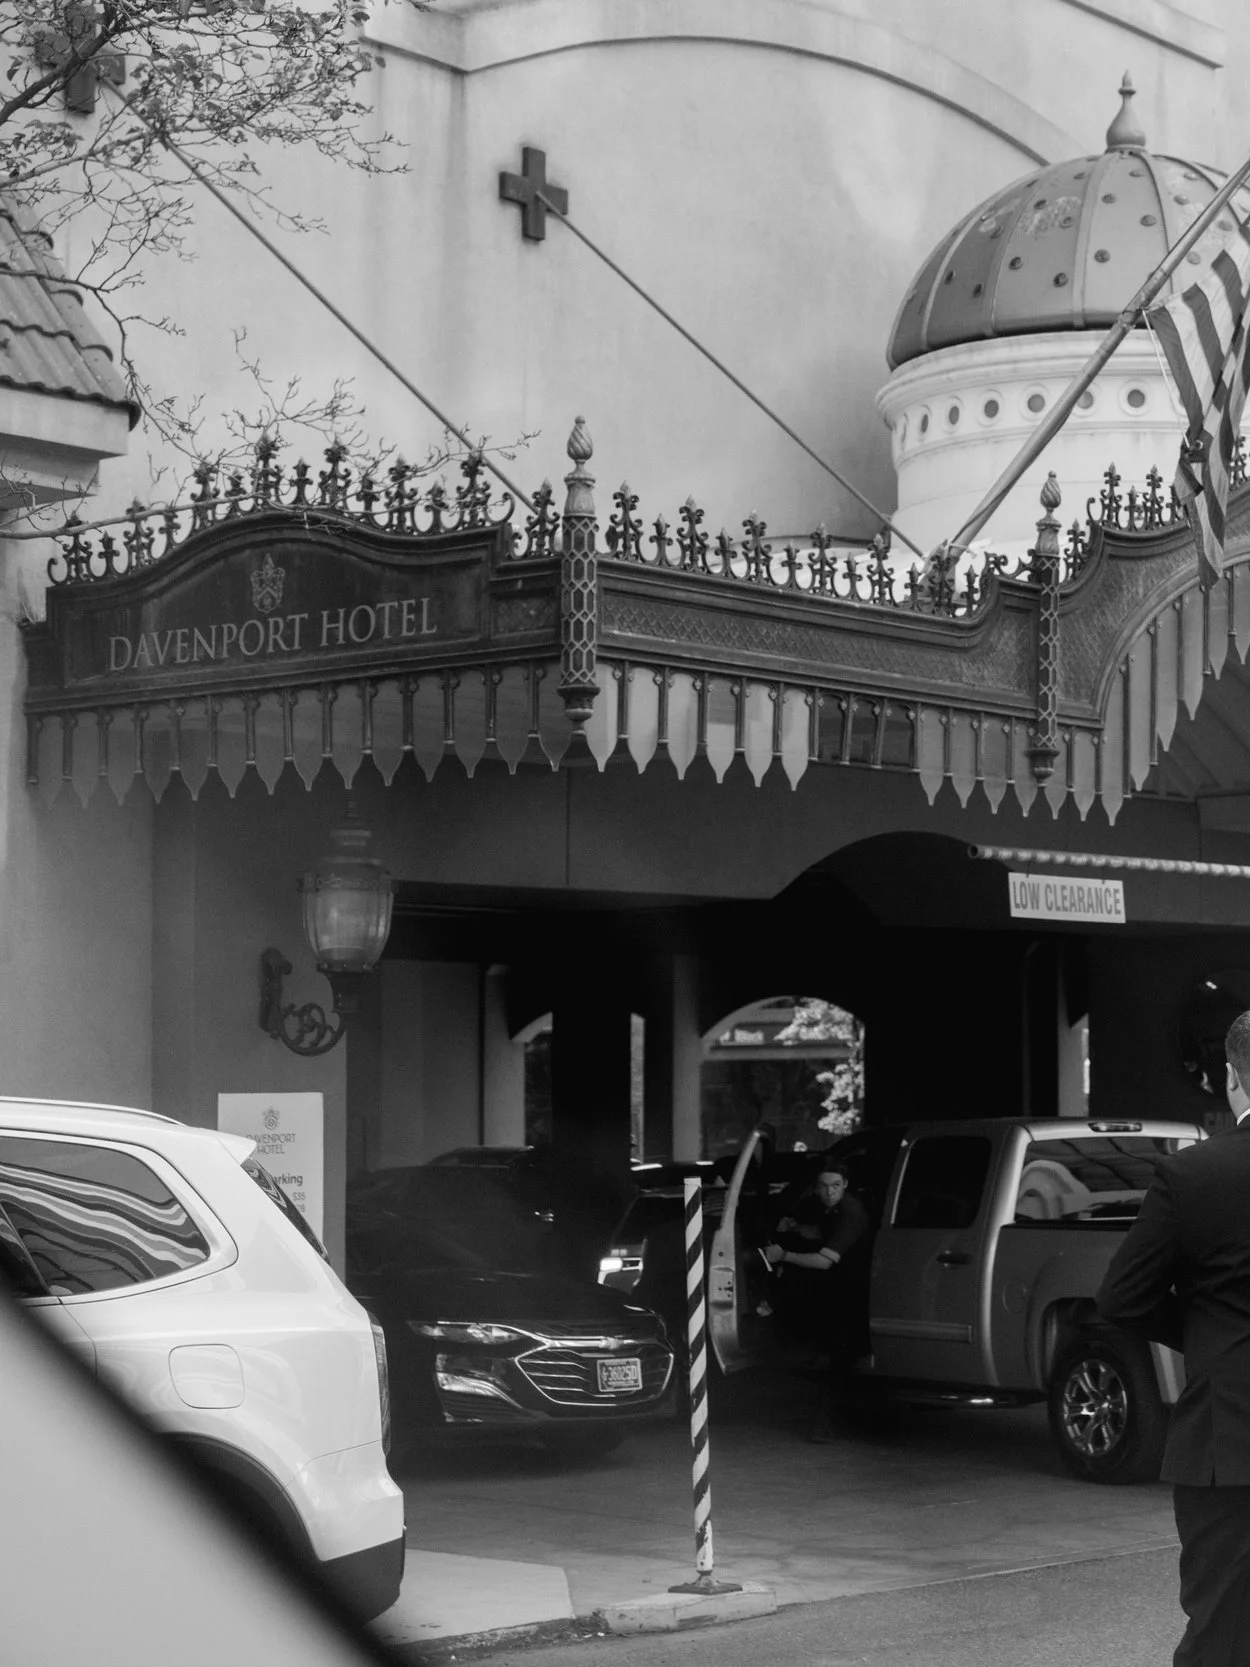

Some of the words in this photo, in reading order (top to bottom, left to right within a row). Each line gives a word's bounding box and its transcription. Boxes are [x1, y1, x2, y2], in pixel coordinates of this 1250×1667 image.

[108, 613, 309, 672] DAVENPORT
[320, 597, 437, 648] HOTEL
[1012, 880, 1040, 911] LOW
[1044, 883, 1122, 915] CLEARANCE
[257, 1144, 285, 1155] HOTEL
[272, 1173, 303, 1187] arking
